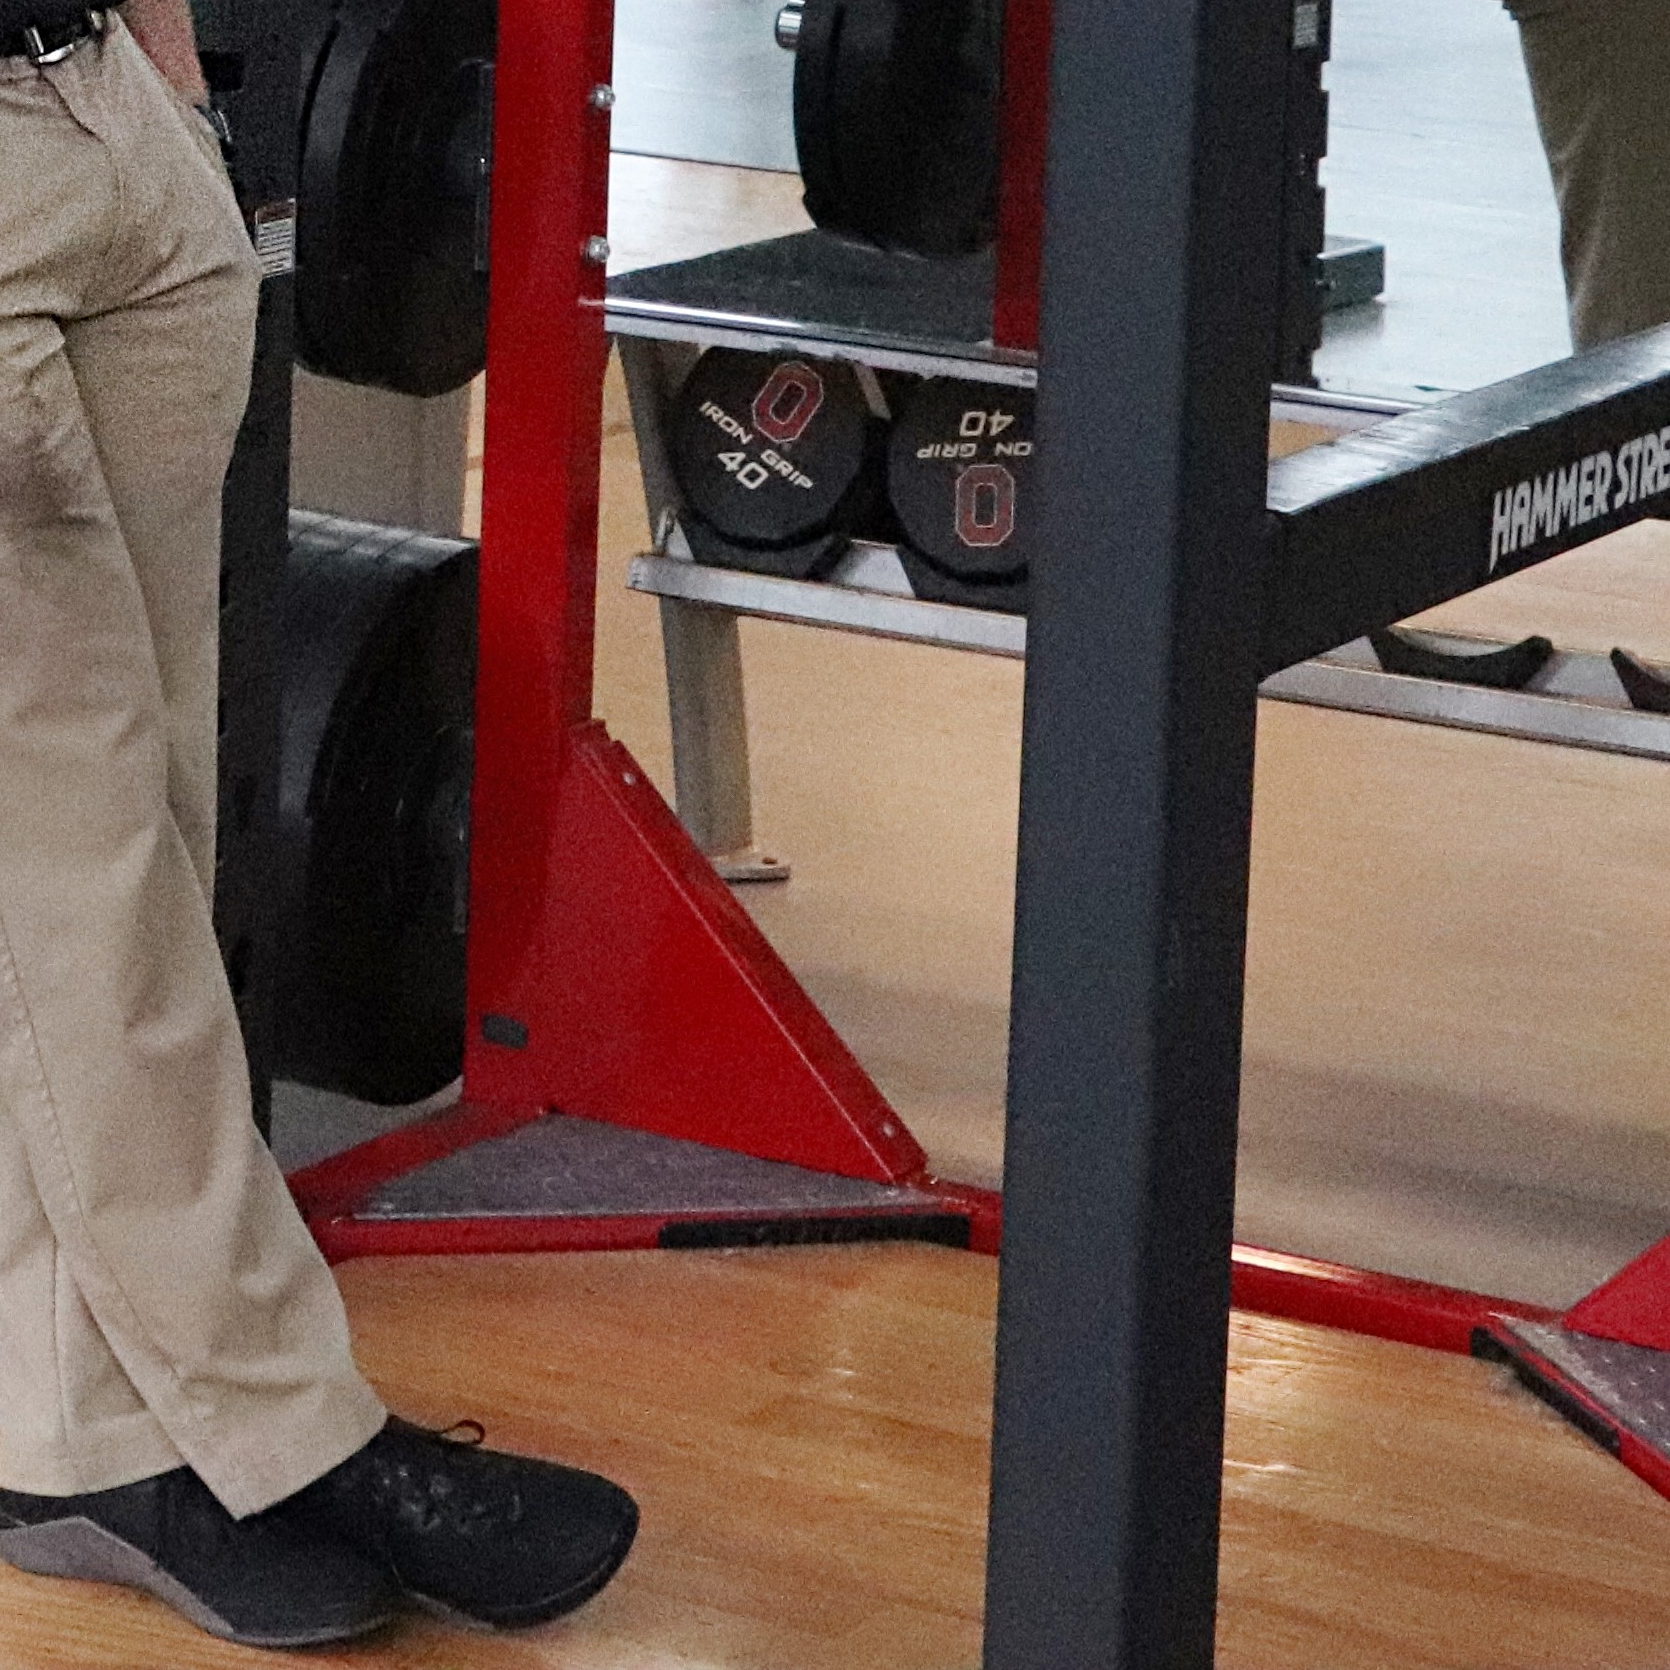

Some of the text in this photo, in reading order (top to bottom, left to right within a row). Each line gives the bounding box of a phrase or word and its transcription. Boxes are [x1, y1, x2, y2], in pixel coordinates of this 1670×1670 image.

[959, 409, 1017, 437] 40
[699, 401, 814, 490] IRON GRIP
[916, 442, 978, 459] GRIP
[716, 451, 770, 490] 40
[1489, 451, 1614, 575] HAMMER
